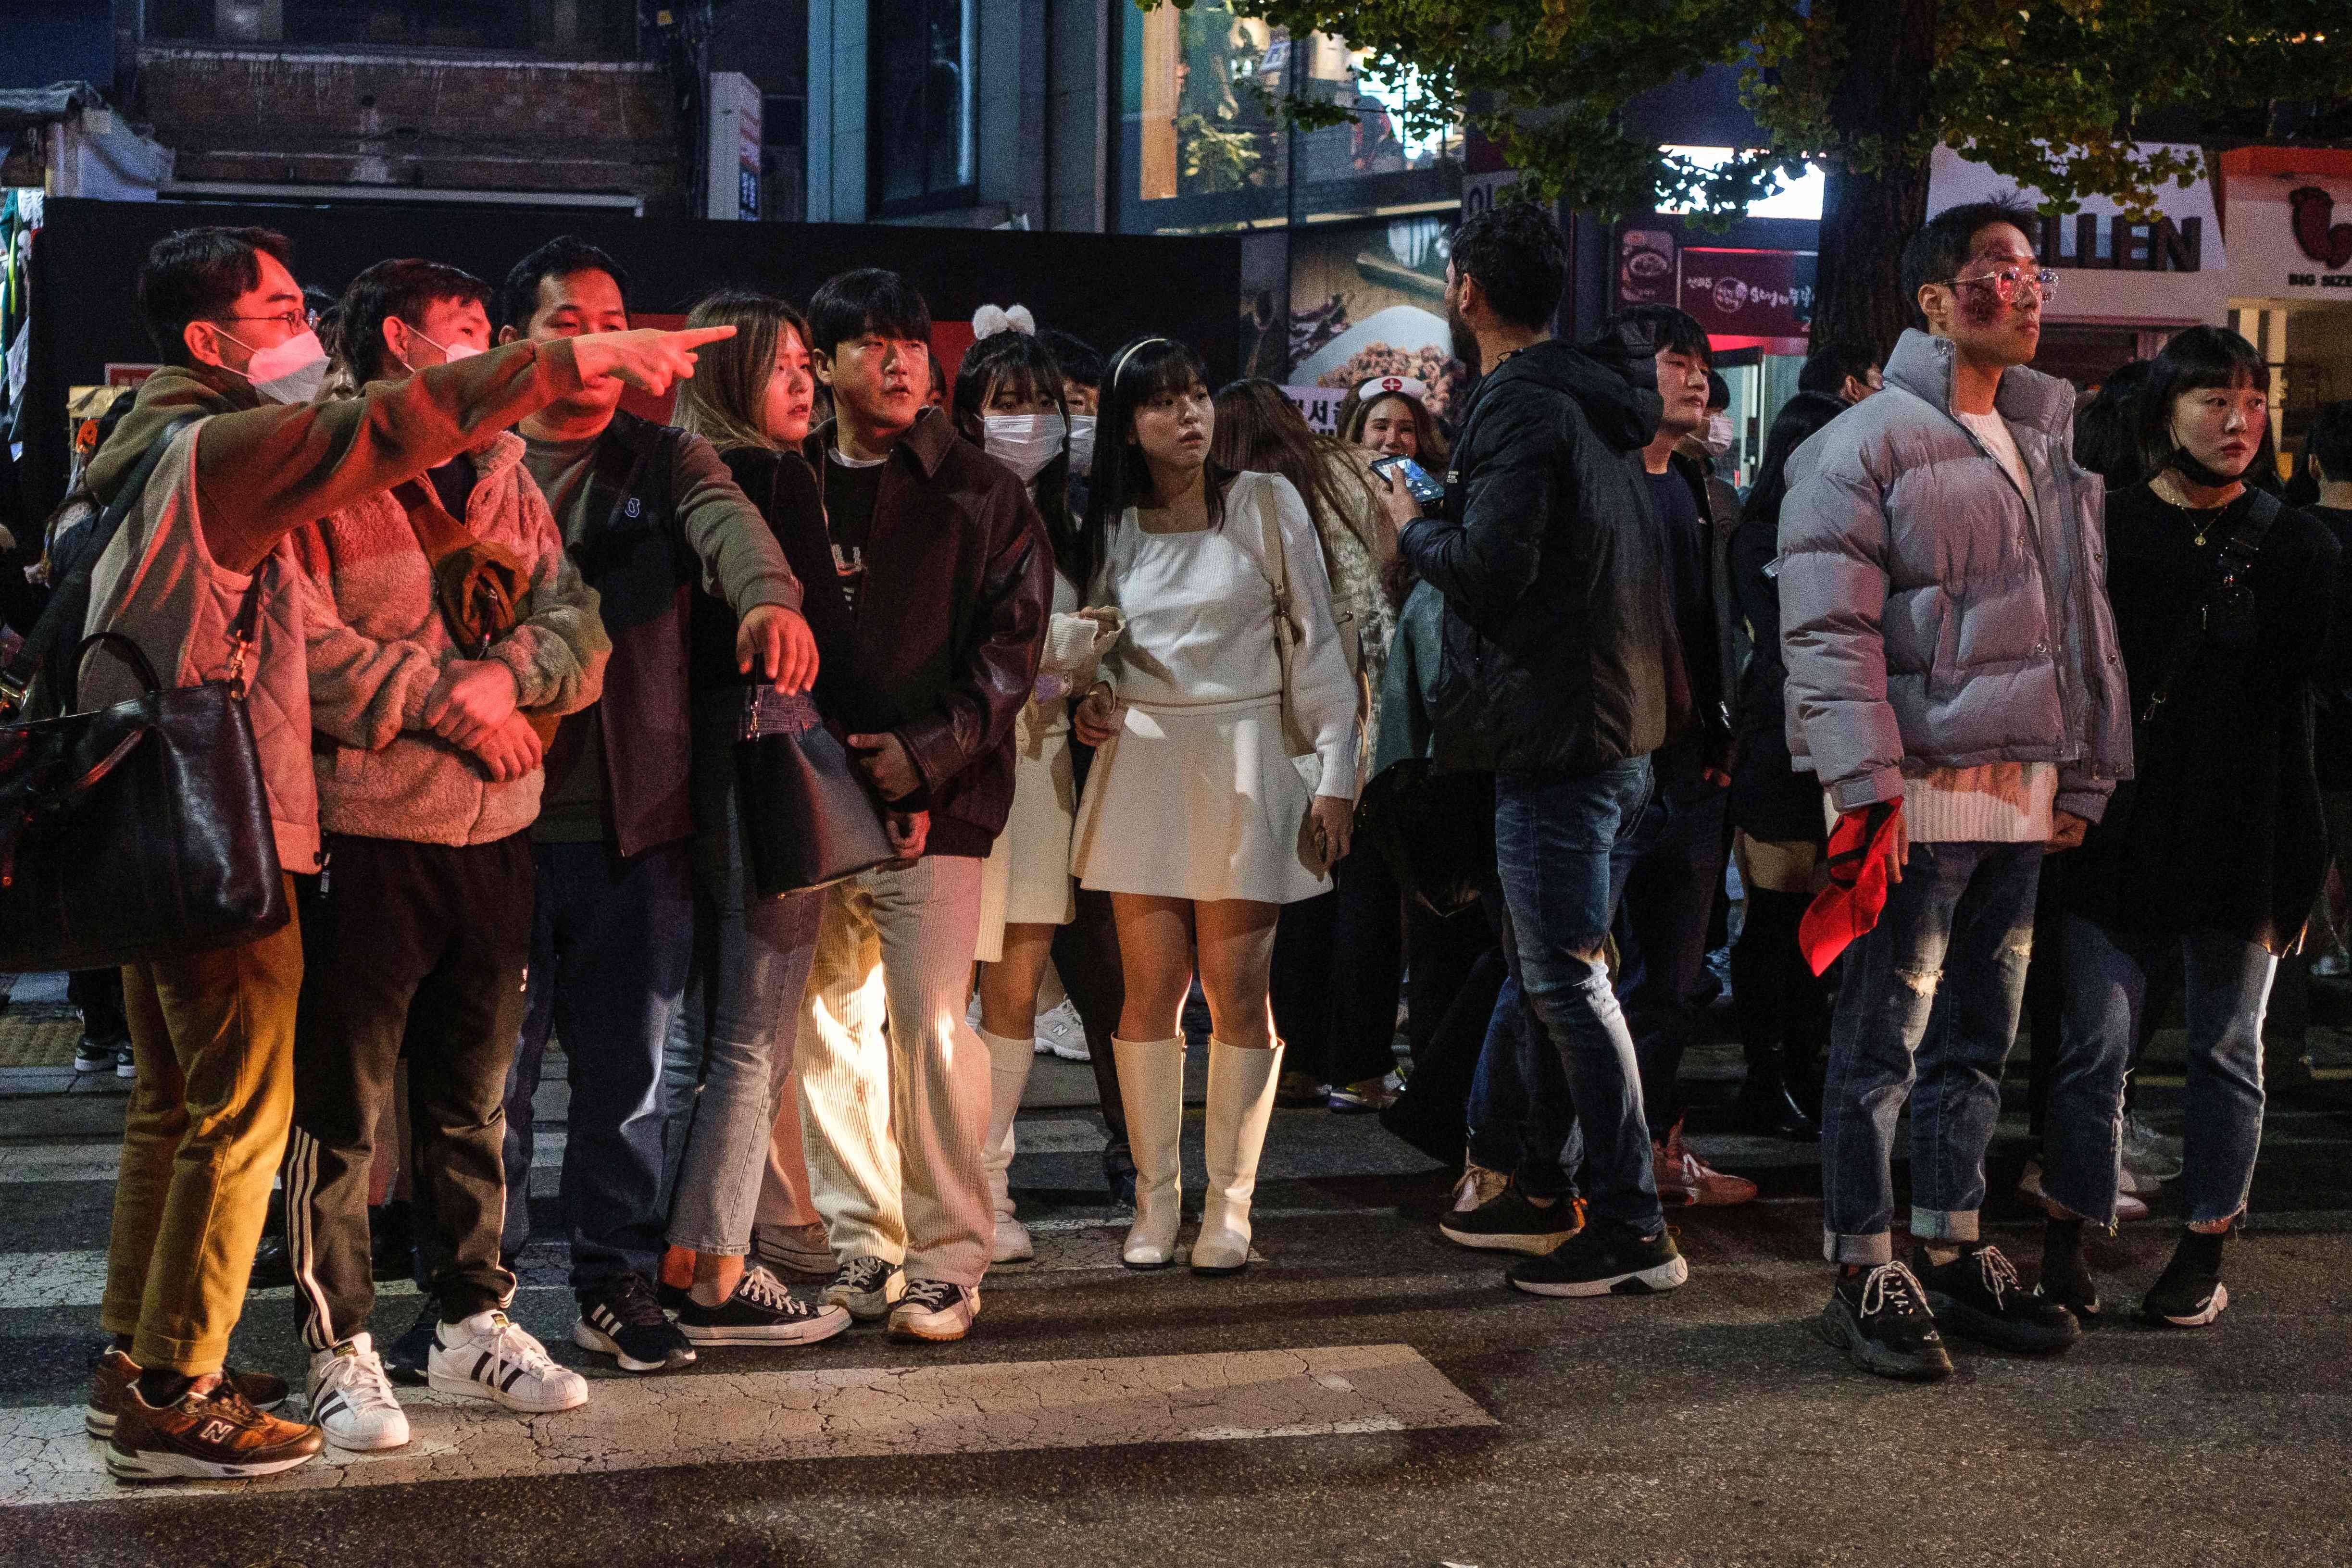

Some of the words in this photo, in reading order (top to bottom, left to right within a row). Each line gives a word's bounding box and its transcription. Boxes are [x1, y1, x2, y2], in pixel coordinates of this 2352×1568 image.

[2033, 213, 2202, 272] LLEN
[2288, 273, 2316, 286] BIG
[200, 1420, 235, 1444] N
